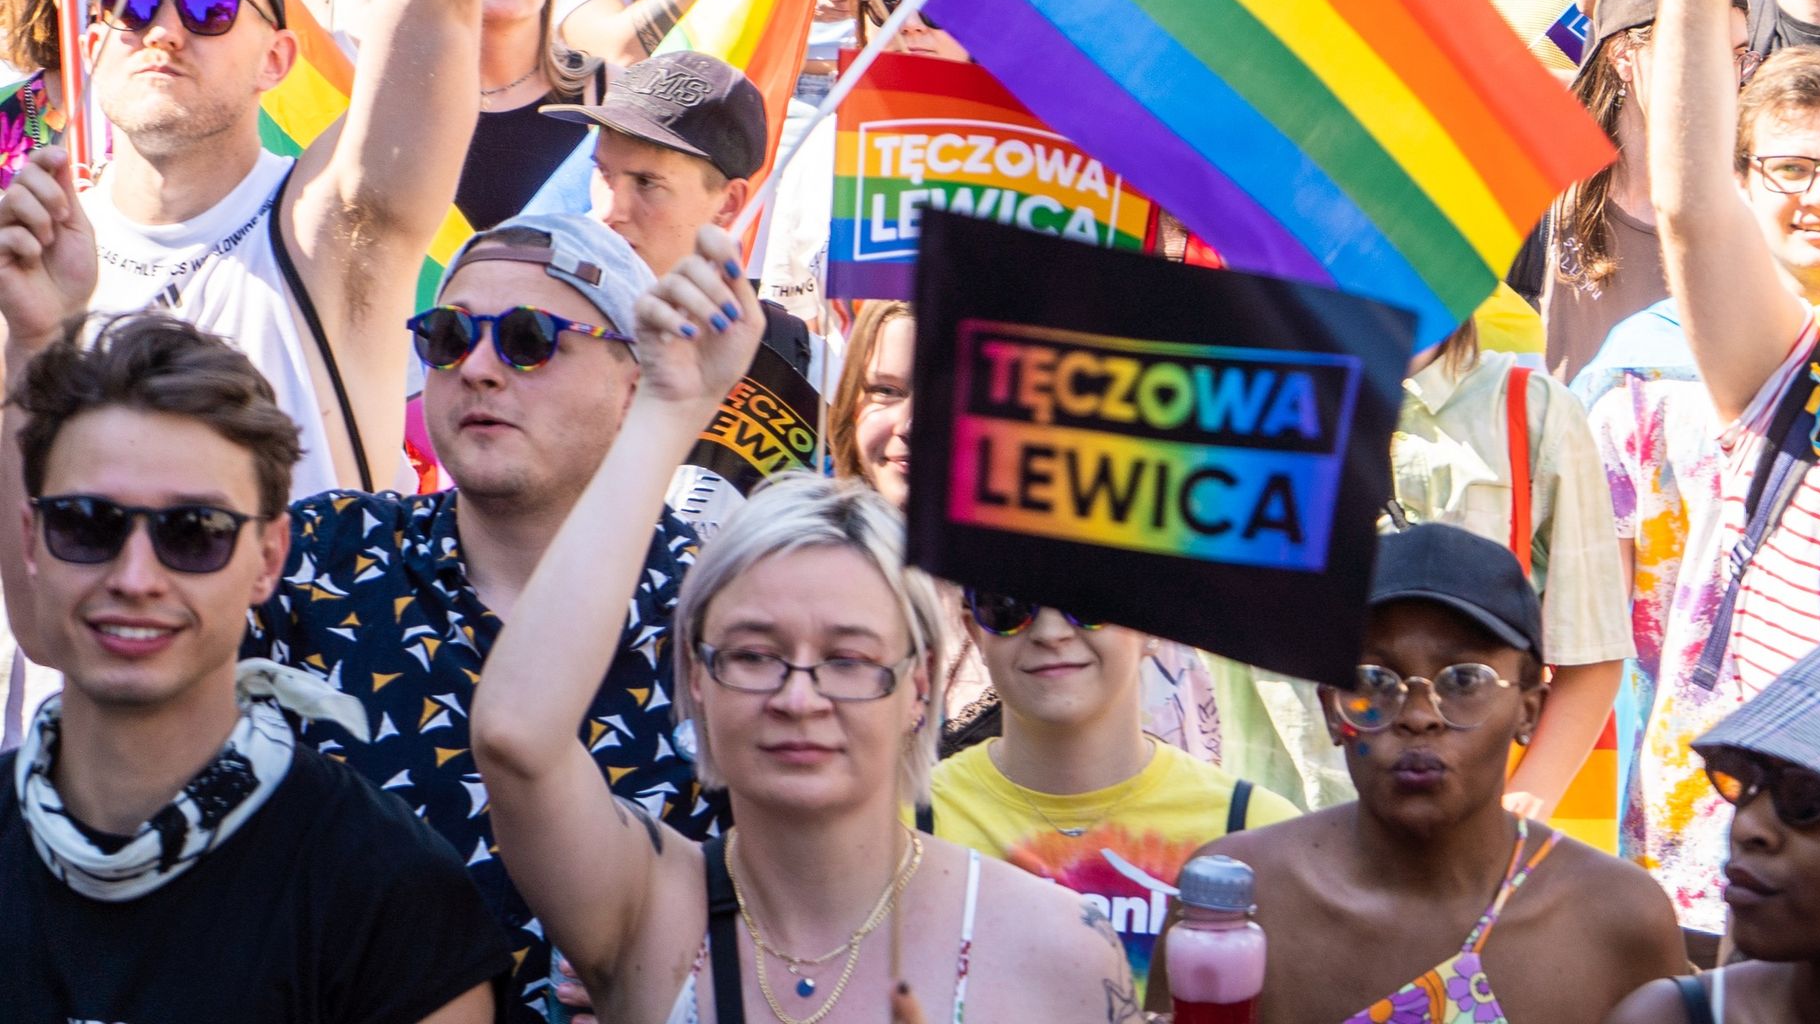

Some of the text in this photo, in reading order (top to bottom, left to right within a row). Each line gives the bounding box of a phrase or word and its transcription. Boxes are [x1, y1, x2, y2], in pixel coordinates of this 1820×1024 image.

[874, 132, 1109, 199] TĘCZOWA
[980, 339, 1321, 440] TĘCZOWA
[974, 435, 1306, 548] LEWICA
